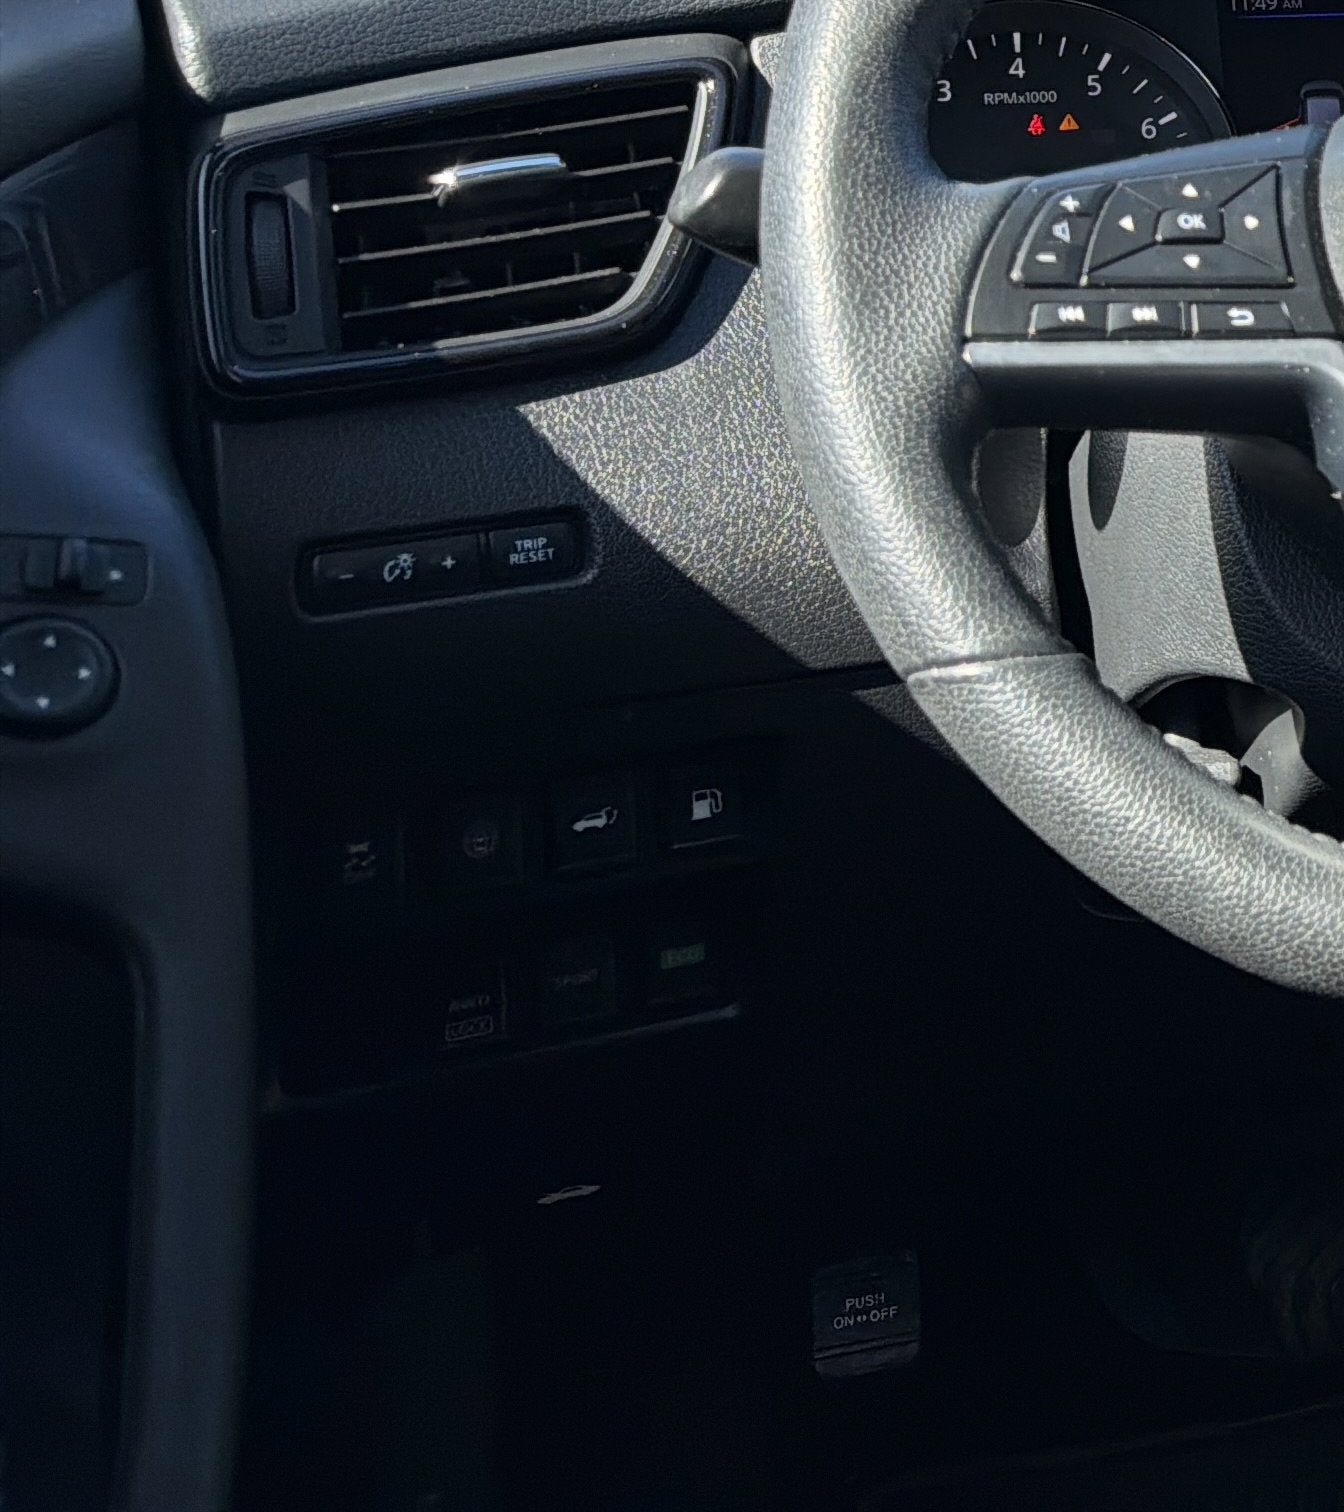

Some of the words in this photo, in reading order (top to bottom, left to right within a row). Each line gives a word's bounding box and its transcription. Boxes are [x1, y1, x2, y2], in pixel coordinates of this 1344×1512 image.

[1008, 57, 1026, 79] 4
[936, 79, 952, 103] 3
[1087, 74, 1102, 97] 5
[1141, 117, 1157, 140] 6
[514, 536, 548, 553] TRIP
[509, 547, 555, 566] RESET
[845, 1292, 885, 1312] PUSH
